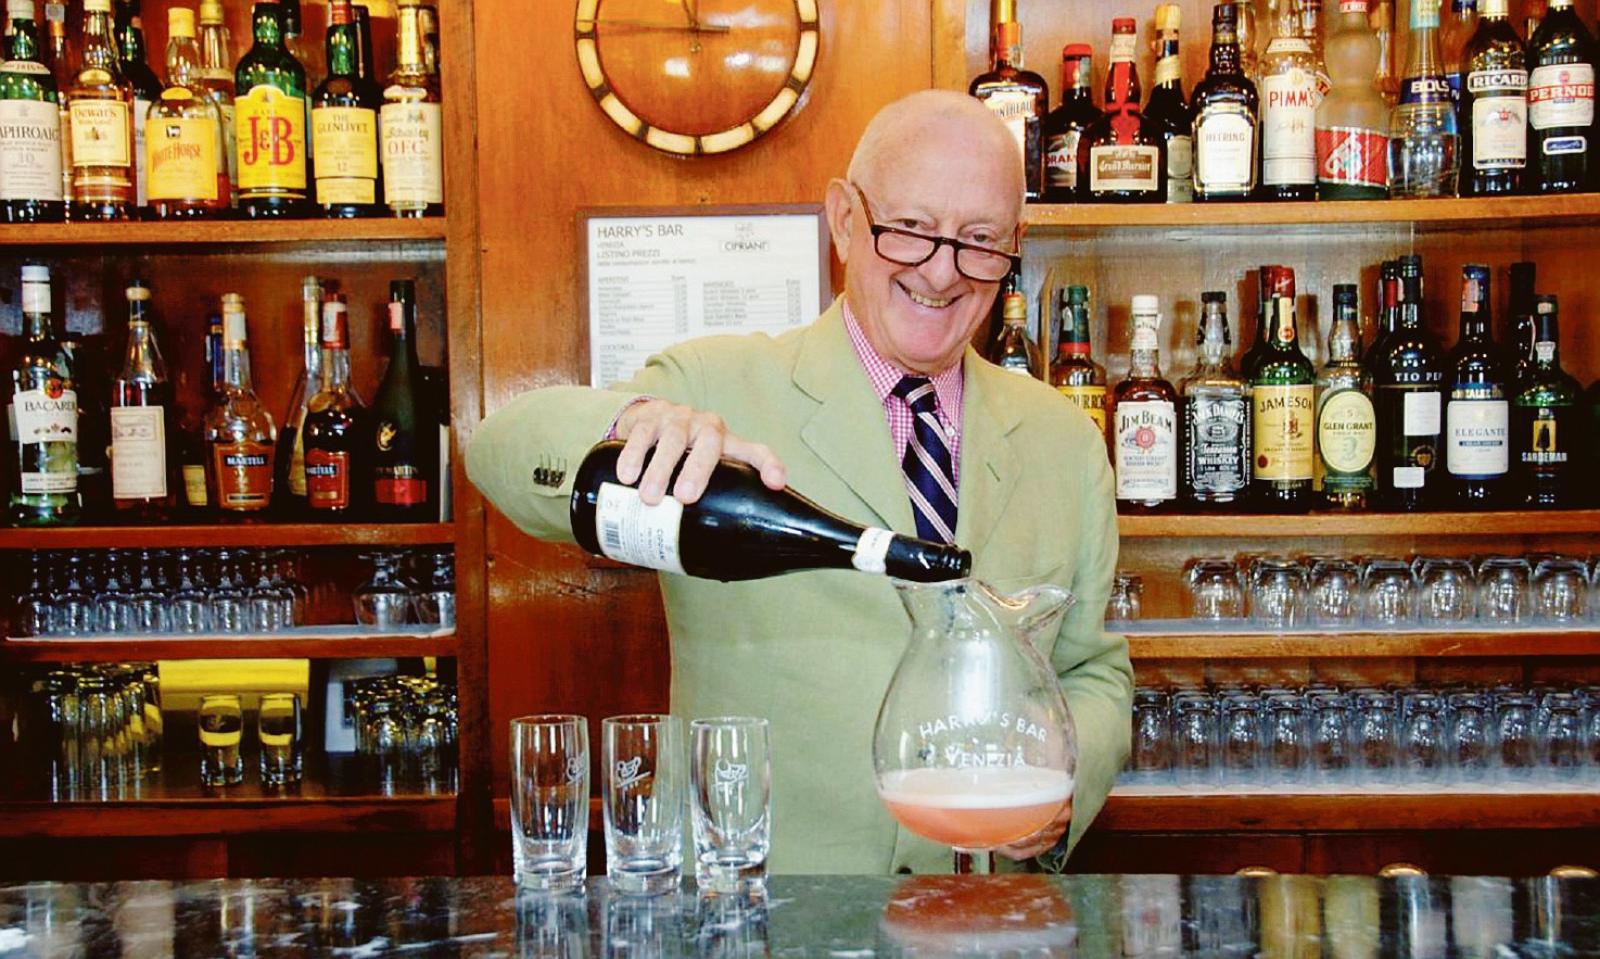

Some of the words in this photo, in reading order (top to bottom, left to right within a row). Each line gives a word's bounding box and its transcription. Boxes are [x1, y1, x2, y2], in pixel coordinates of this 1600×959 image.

[1411, 80, 1450, 94] BOLS
[597, 225, 653, 238] HARRY'S
[658, 223, 684, 236] BAR
[1395, 372, 1420, 382] TIO
[1120, 415, 1139, 433] JIM
[1142, 410, 1172, 432] BEAM
[1323, 422, 1344, 430] GLEN
[1346, 422, 1373, 430] GRANT
[1016, 717, 1048, 743] BAR
